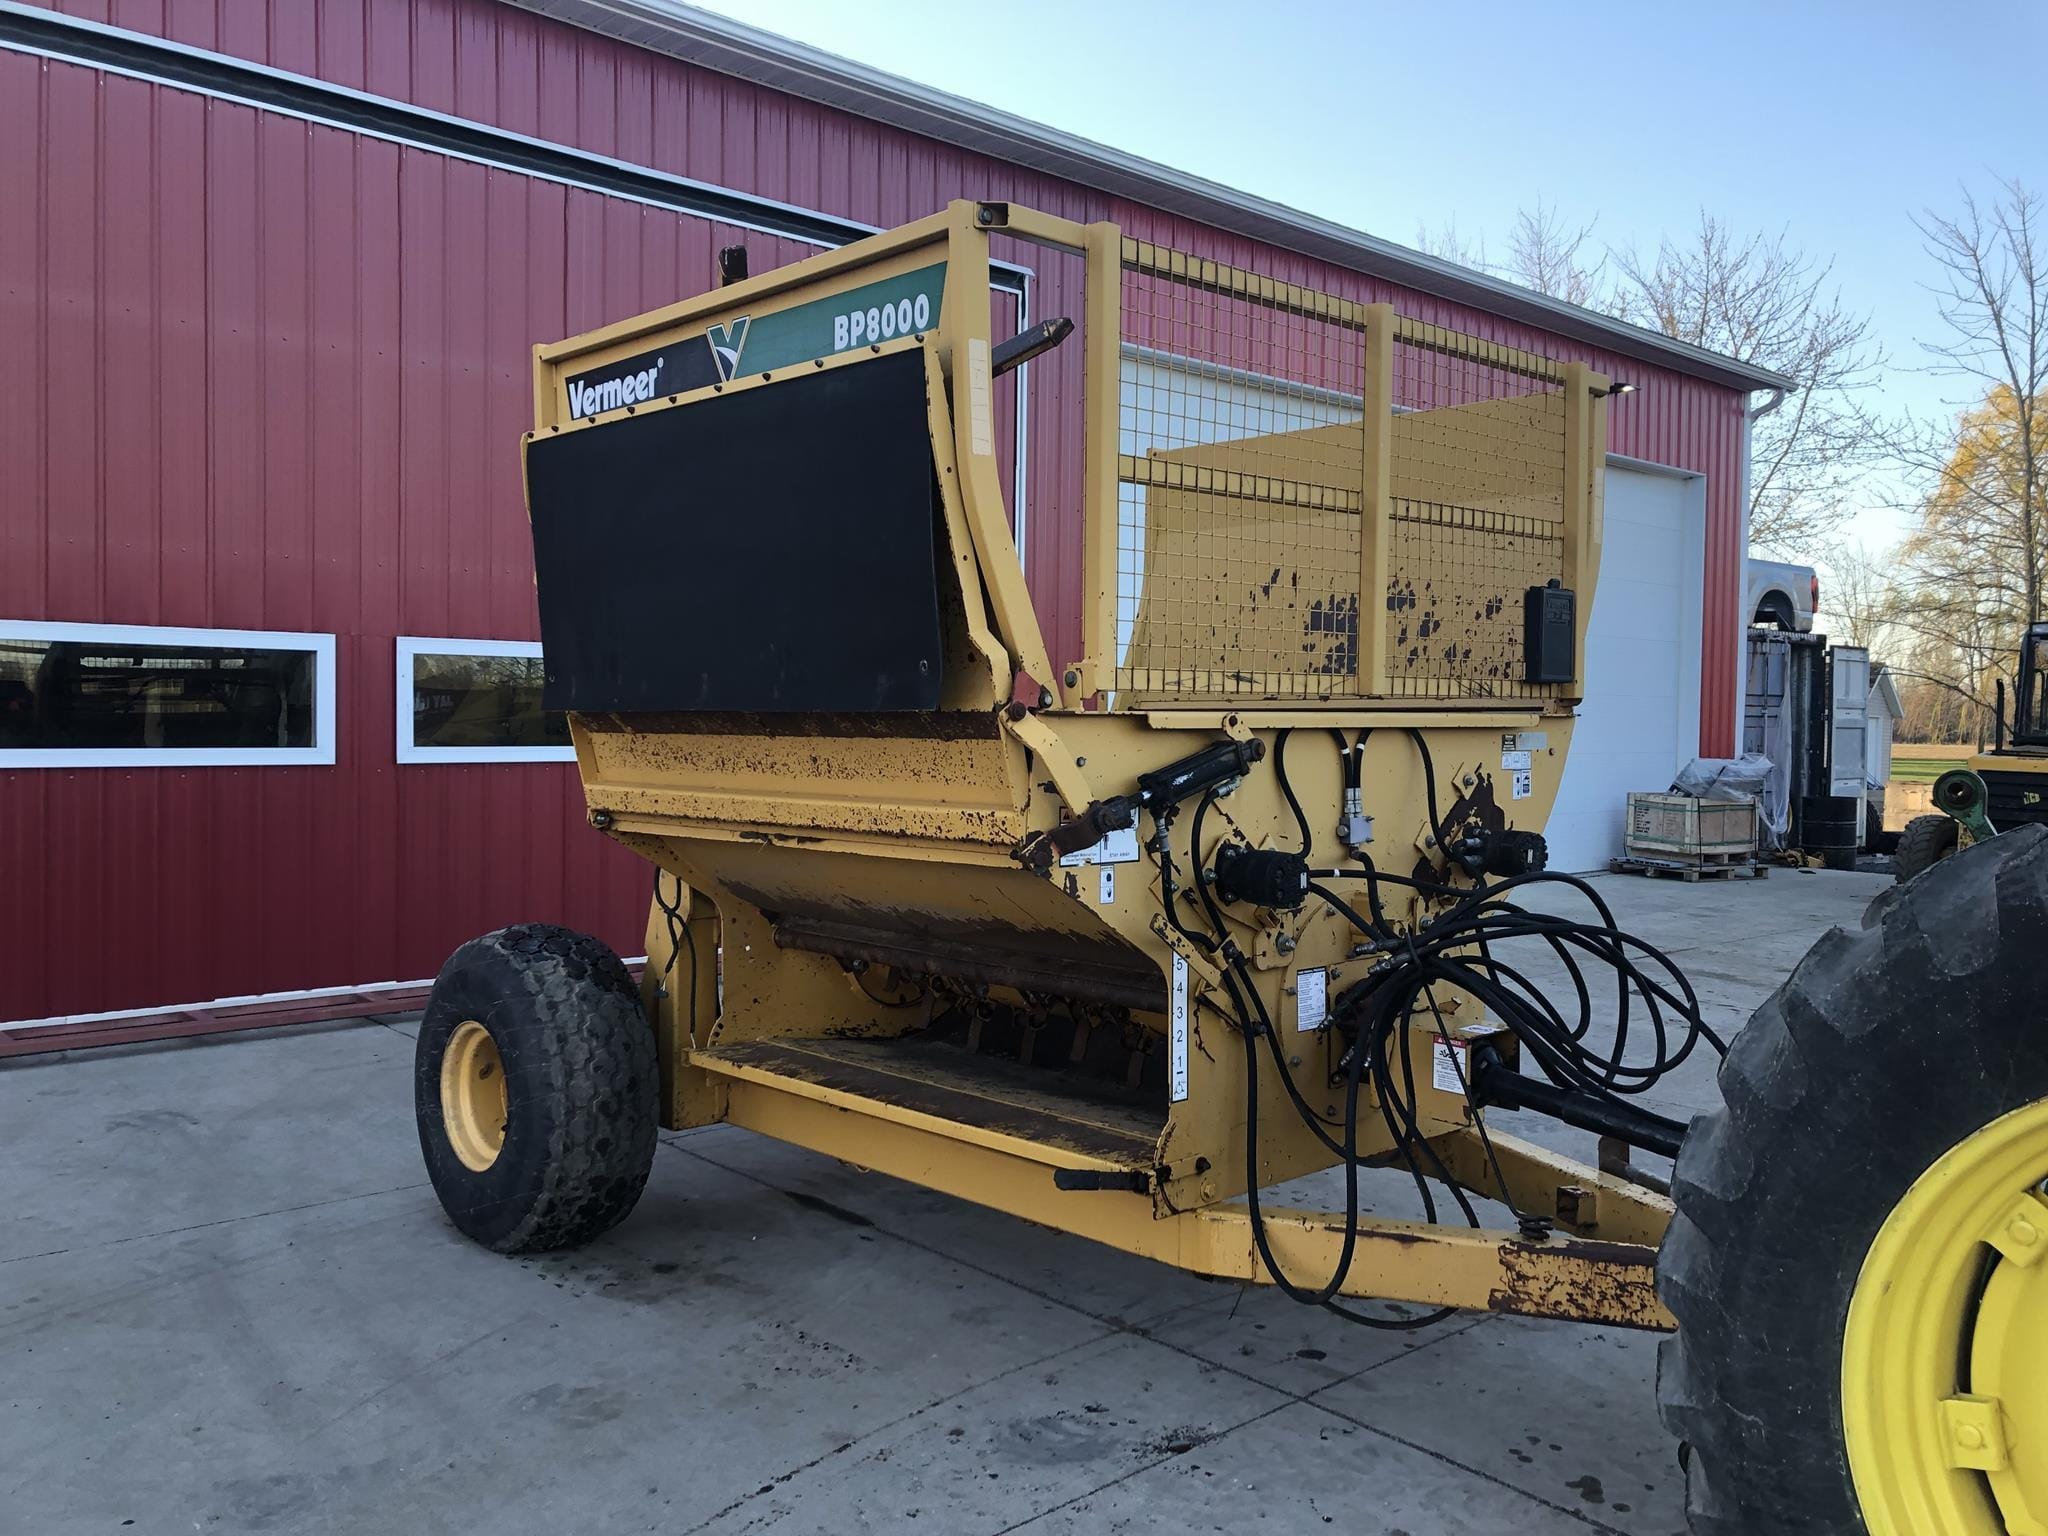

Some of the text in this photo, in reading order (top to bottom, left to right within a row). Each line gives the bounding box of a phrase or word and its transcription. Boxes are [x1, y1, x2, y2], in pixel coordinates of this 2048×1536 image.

[834, 293, 930, 351] BP8000
[568, 366, 659, 419] Vermeer
[2024, 791, 2040, 805] JCB
[1176, 958, 1183, 971] 5
[1176, 981, 1183, 994] 4
[1176, 1006, 1183, 1019] 3
[1176, 1030, 1183, 1043] 2
[1178, 1056, 1182, 1067] 1
